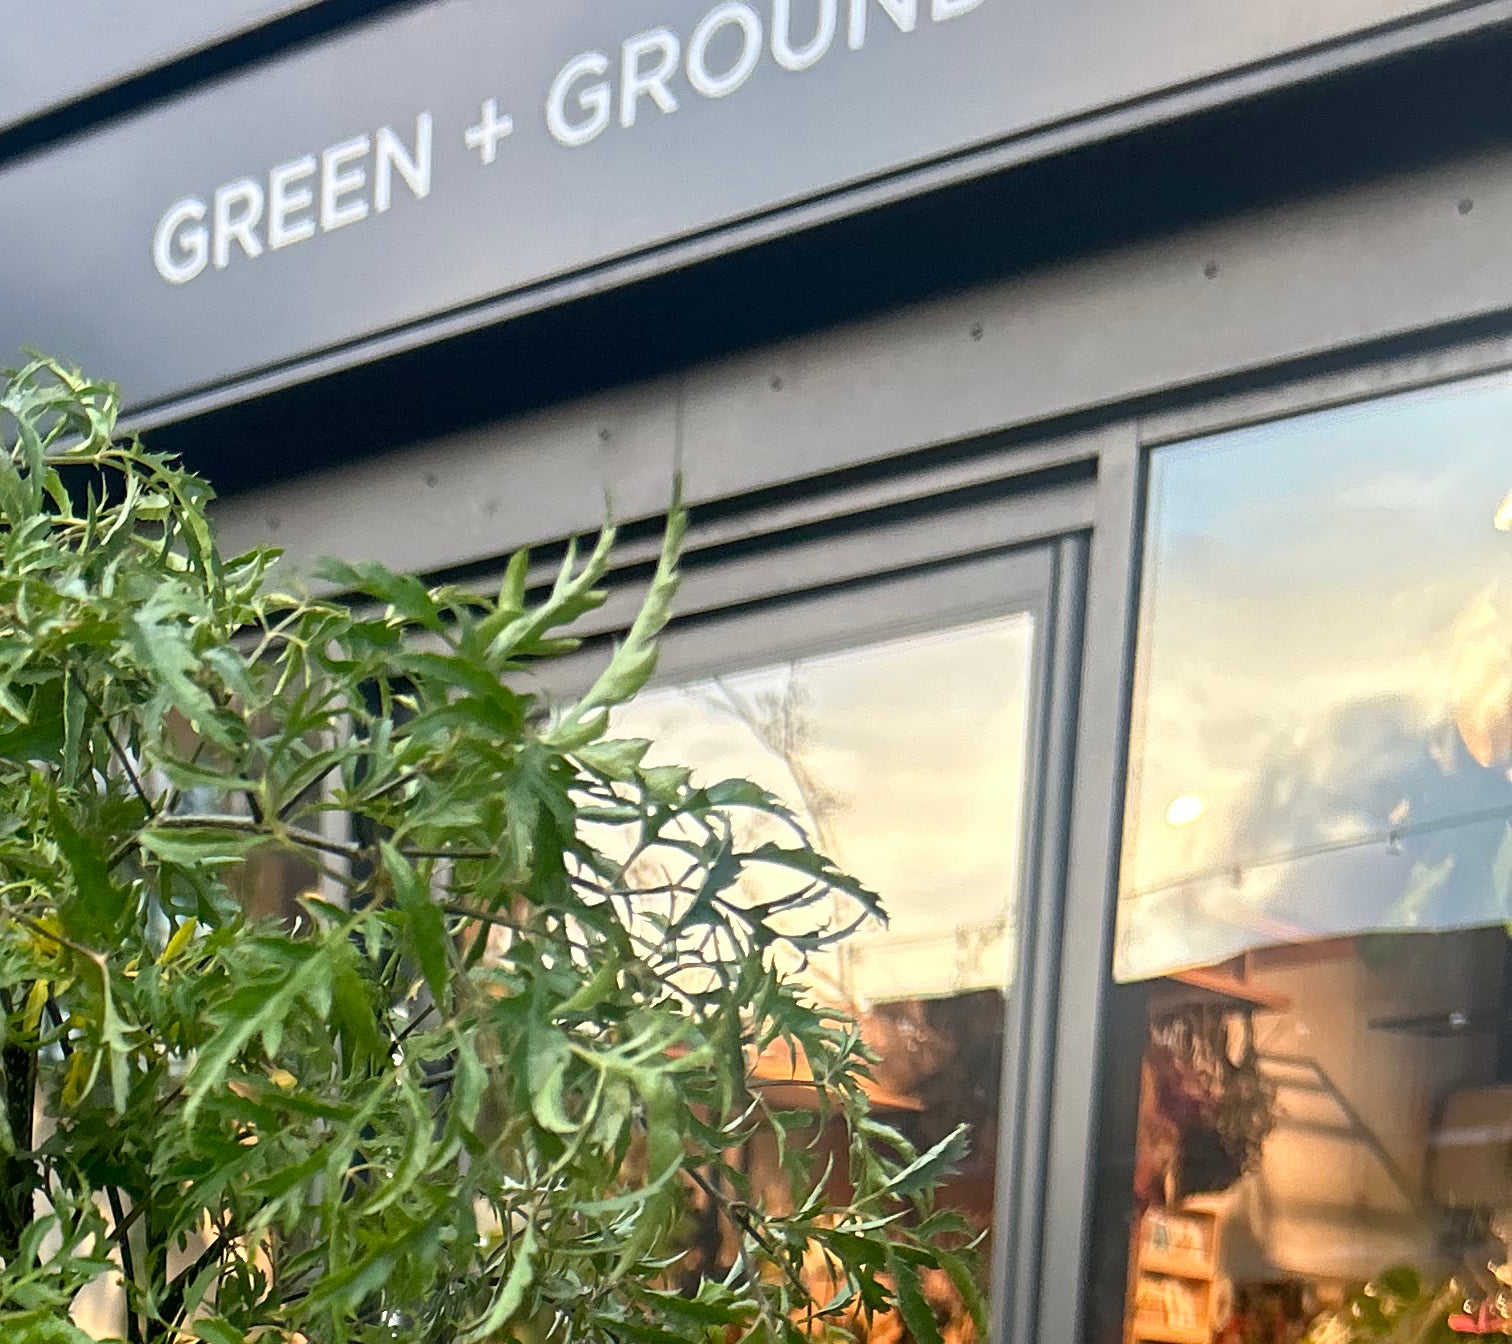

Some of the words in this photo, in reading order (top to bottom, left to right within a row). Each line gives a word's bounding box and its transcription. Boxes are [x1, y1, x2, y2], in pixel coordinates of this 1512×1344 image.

[153, 111, 433, 285] GREEN
[464, 98, 514, 165] +
[546, 0, 986, 148] GROU
